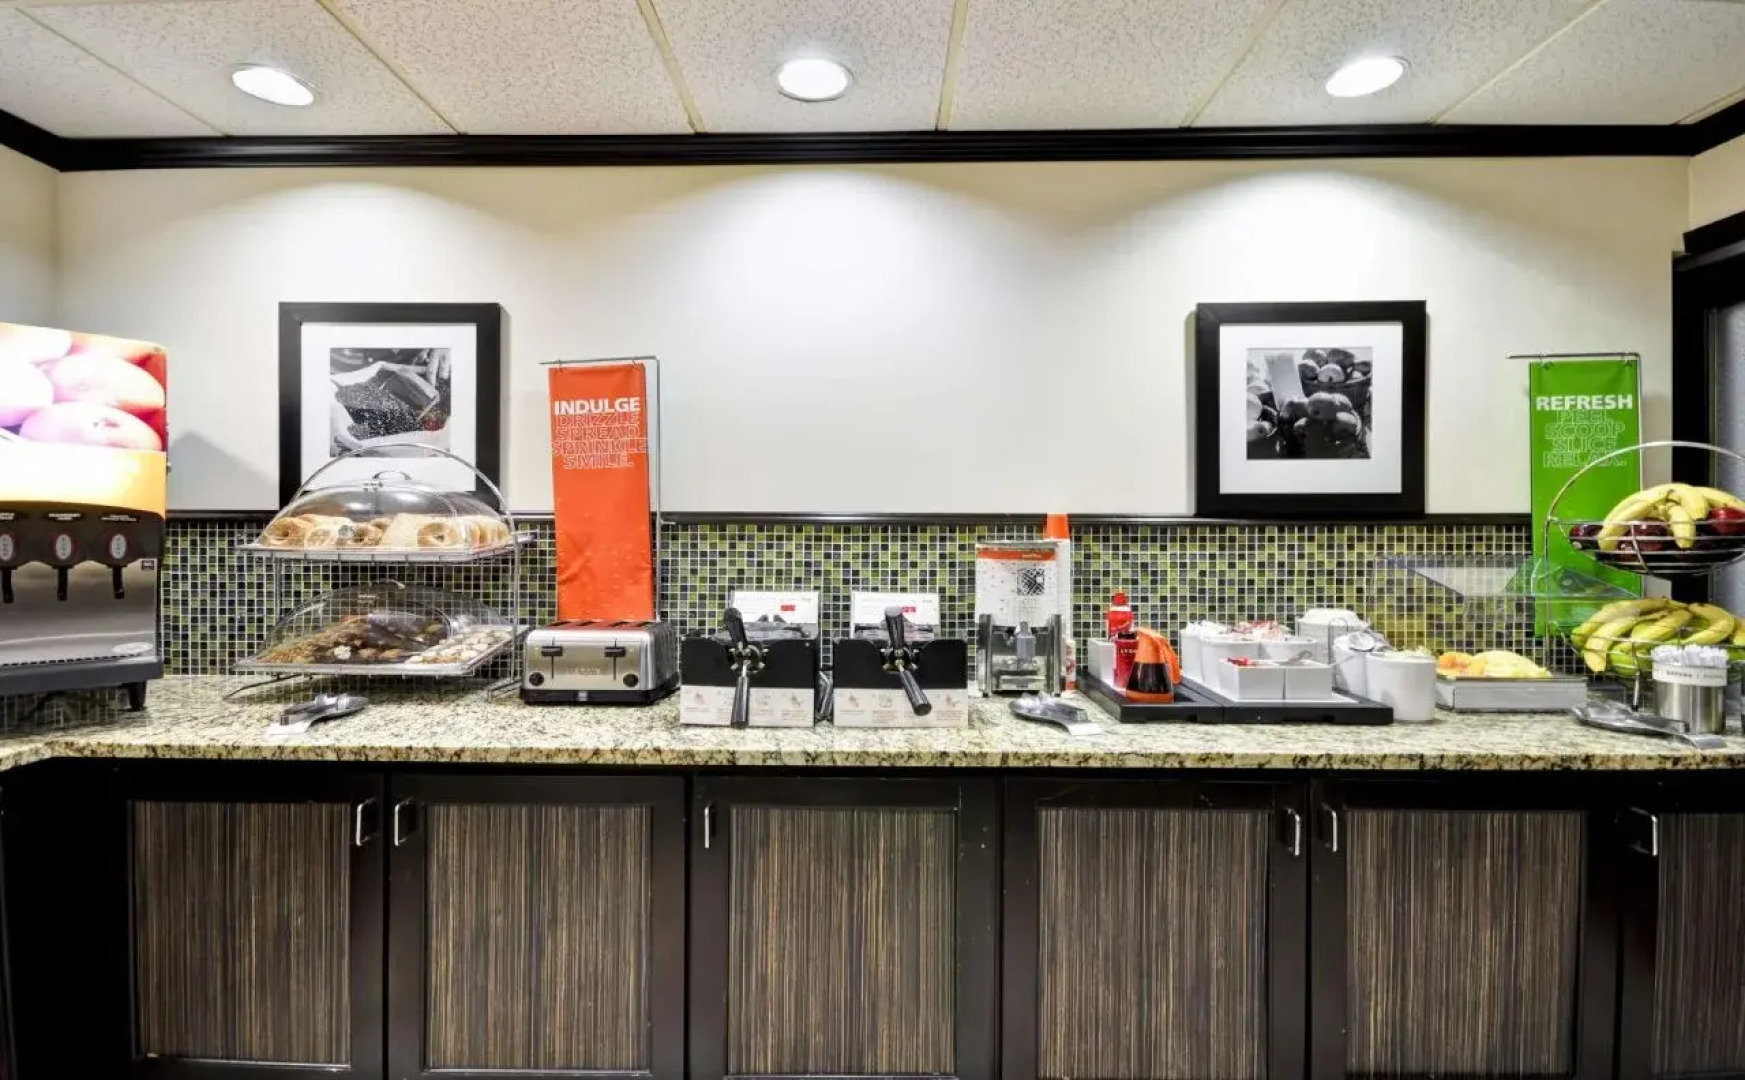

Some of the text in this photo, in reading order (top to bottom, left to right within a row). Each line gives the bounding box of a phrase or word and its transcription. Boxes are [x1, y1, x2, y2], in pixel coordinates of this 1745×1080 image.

[554, 397, 641, 415] INDULGE
[1536, 394, 1633, 411] REFRESH
[555, 411, 640, 427] DRIZZLE
[1556, 408, 1607, 424] PEEL
[556, 424, 640, 441] SPREAD
[1544, 420, 1626, 439] SCOOP
[550, 438, 653, 454] SPRINKLE
[1552, 437, 1617, 453] SLICE
